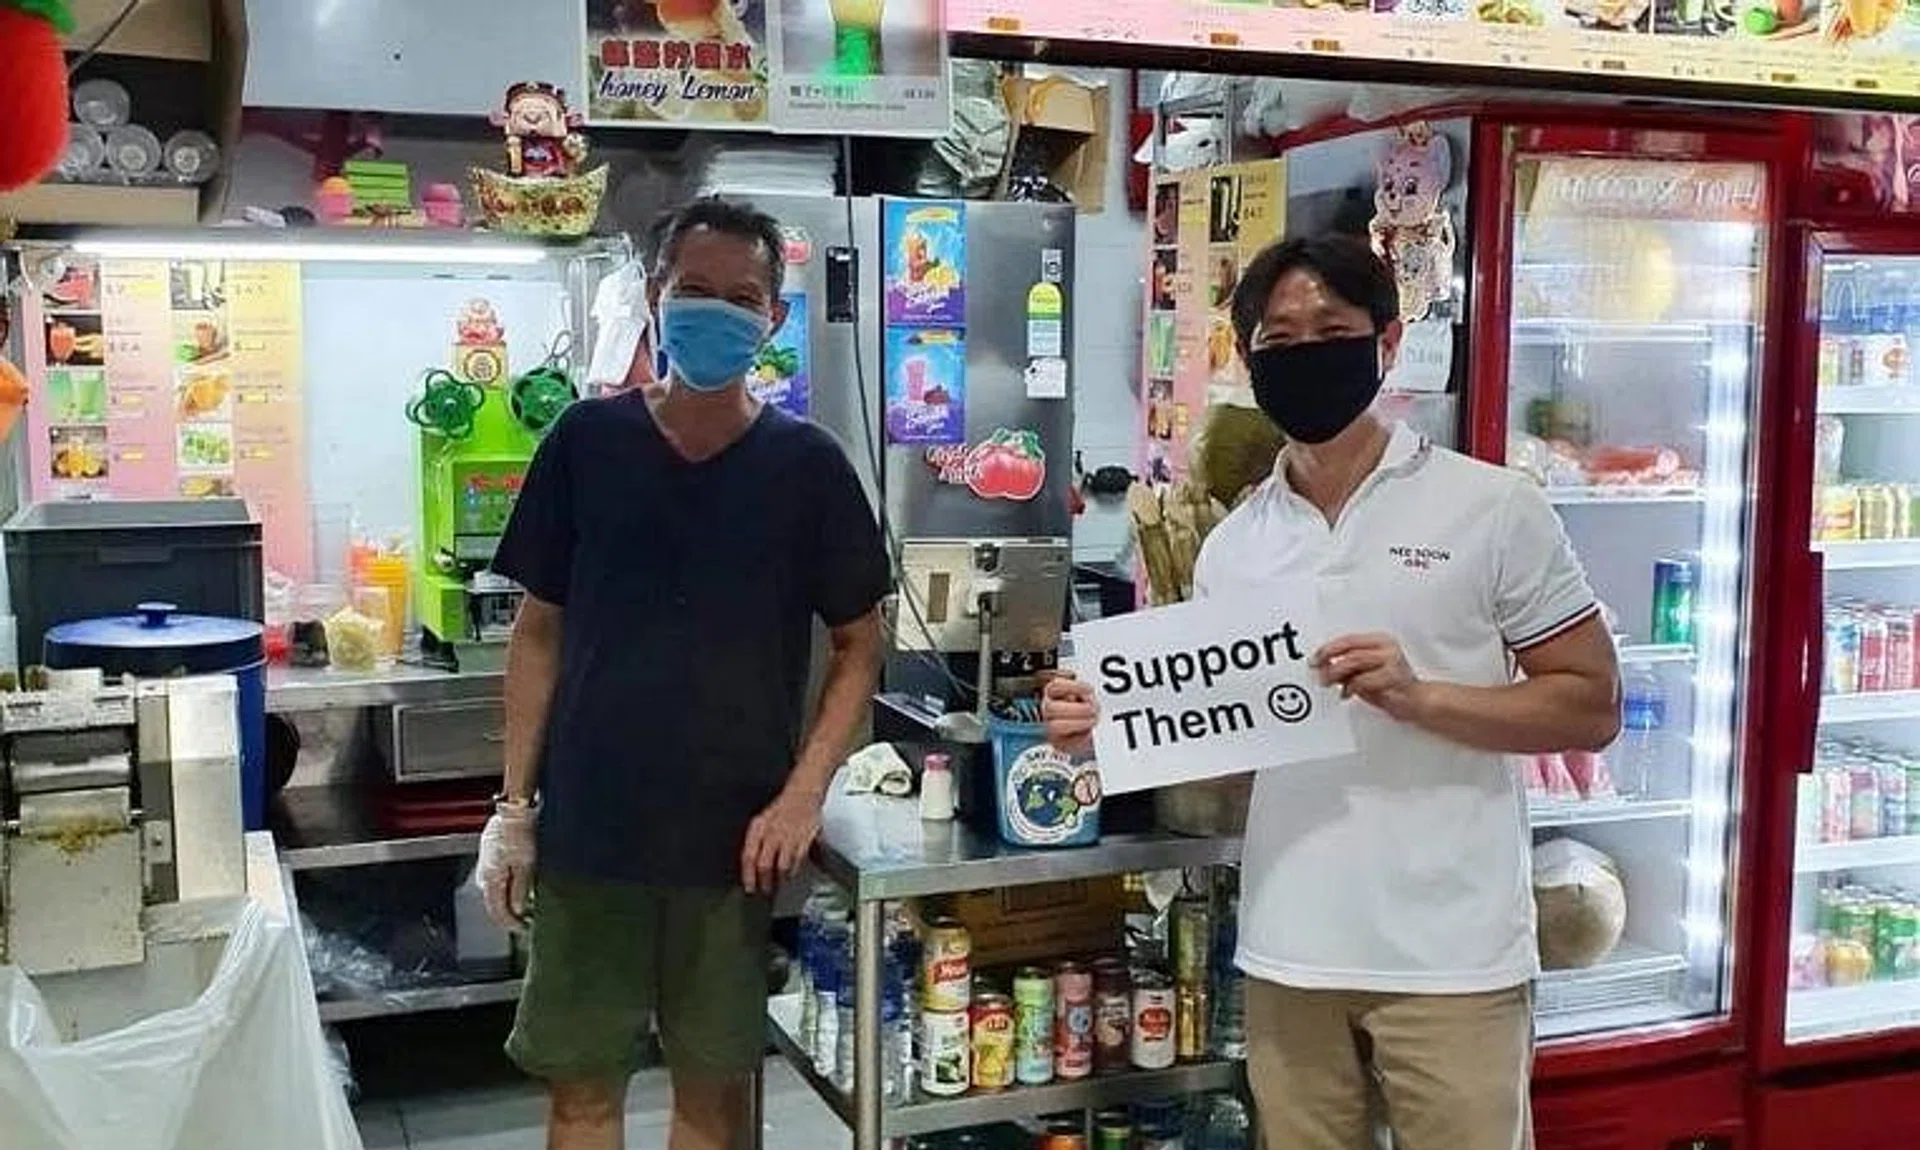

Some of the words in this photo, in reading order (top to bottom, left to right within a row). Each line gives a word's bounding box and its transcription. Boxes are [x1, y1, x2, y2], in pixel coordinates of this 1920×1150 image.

[600, 71, 668, 106] honey
[682, 75, 754, 100] Lemon
[1100, 621, 1304, 696] Support
[1112, 698, 1255, 750] Them
